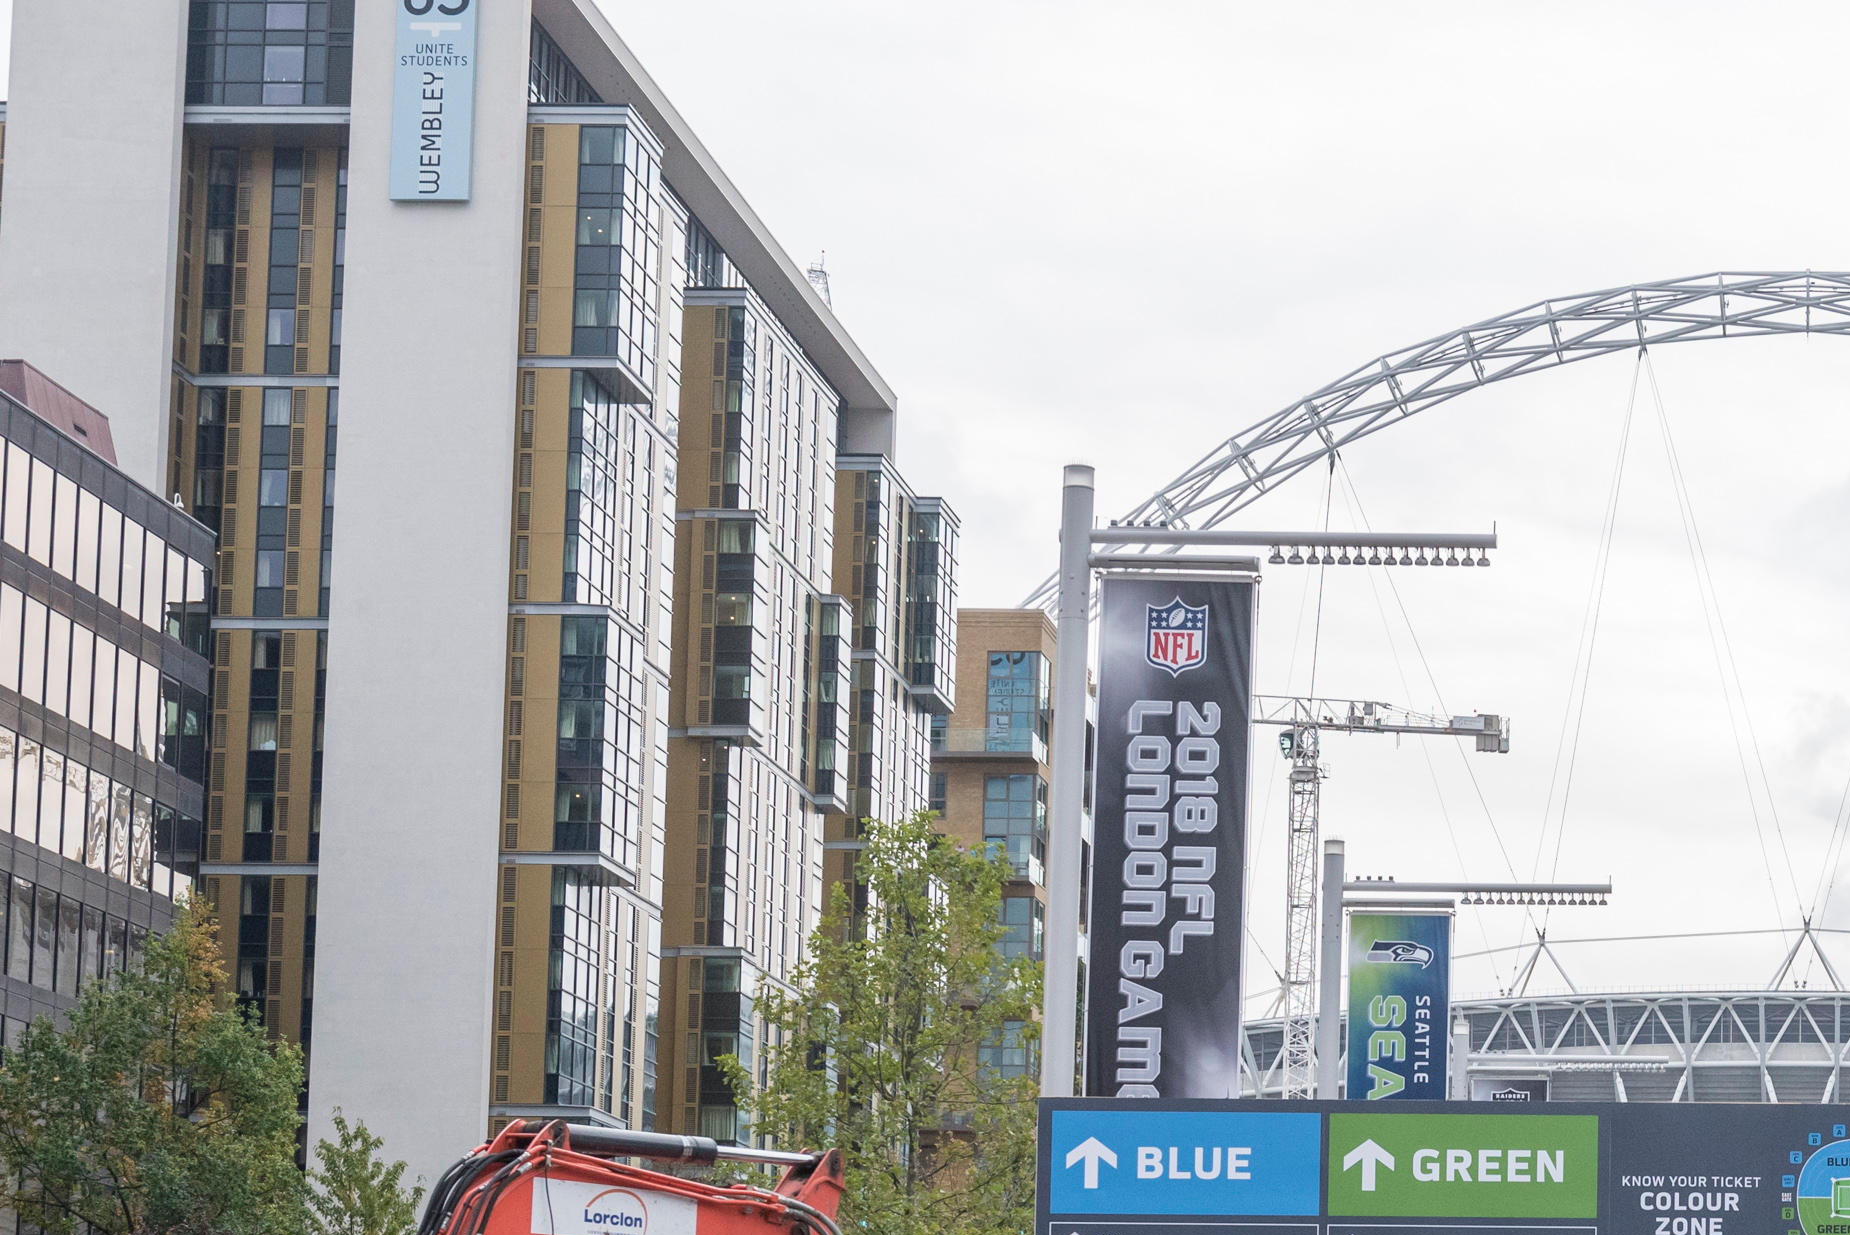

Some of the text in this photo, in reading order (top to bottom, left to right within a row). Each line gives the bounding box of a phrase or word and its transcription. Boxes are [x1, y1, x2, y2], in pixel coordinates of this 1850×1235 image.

[401, 56, 468, 66] STUDENTS
[416, 44, 454, 54] UNITE
[418, 72, 444, 194] WEMBLEY
[1152, 631, 1199, 664] NFL
[1121, 700, 1173, 927] LONDON
[1168, 700, 1222, 955] 2018 NFL
[1414, 995, 1431, 1083] SEATTLE
[1136, 1146, 1252, 1180] BLUE
[1411, 1148, 1565, 1184] GREEN
[1622, 1176, 1761, 1188] KNOW YOUR TICKET
[1640, 1192, 1740, 1212] COLOUR
